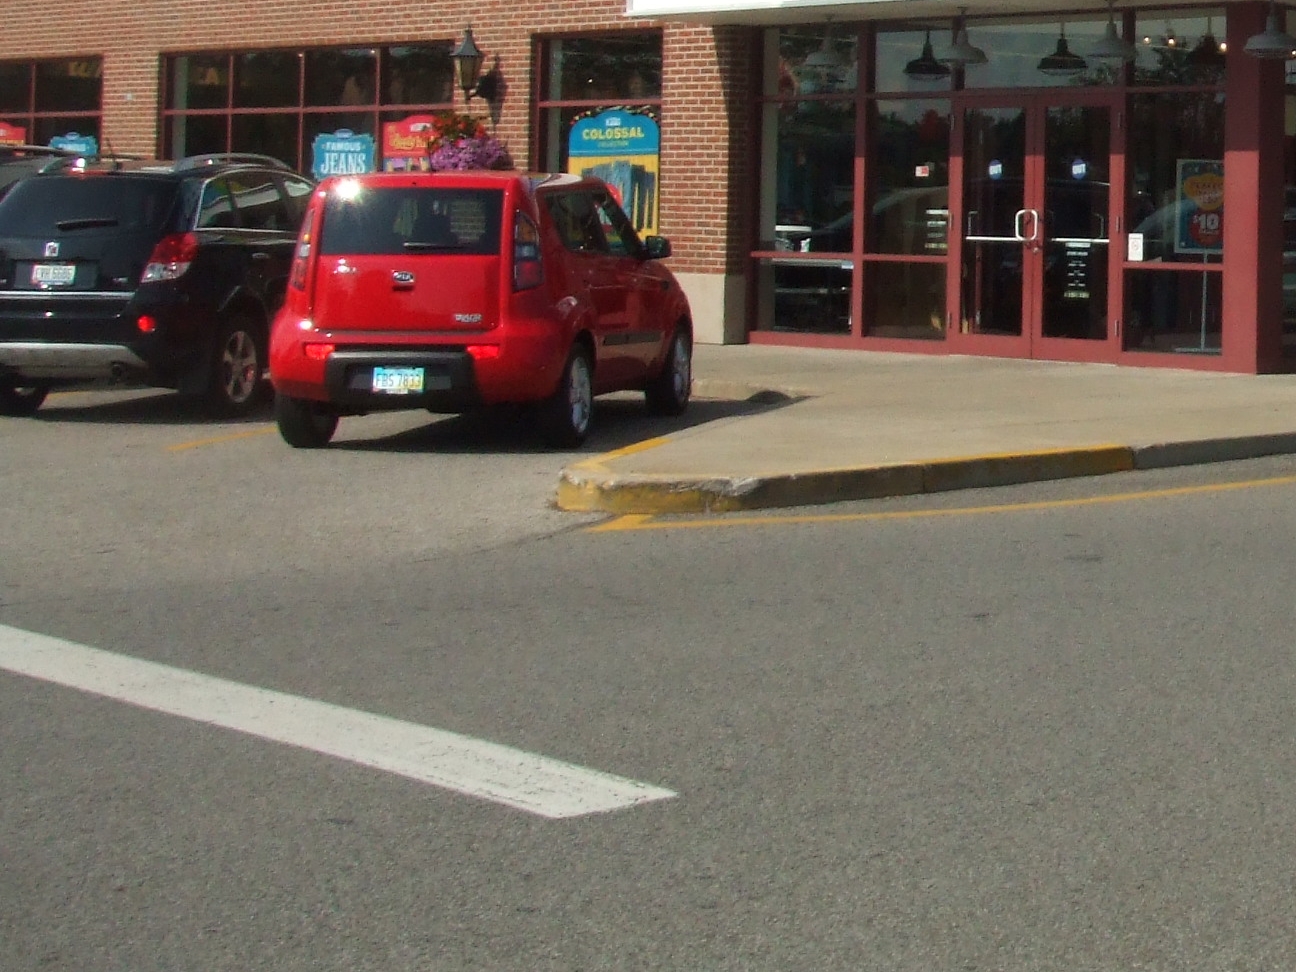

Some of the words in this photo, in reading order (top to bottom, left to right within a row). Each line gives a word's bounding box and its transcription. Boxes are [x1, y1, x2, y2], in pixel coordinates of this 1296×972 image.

[582, 127, 645, 140] COLOSSAL
[326, 141, 361, 151] FAMOUS
[321, 152, 366, 174] JEANS
